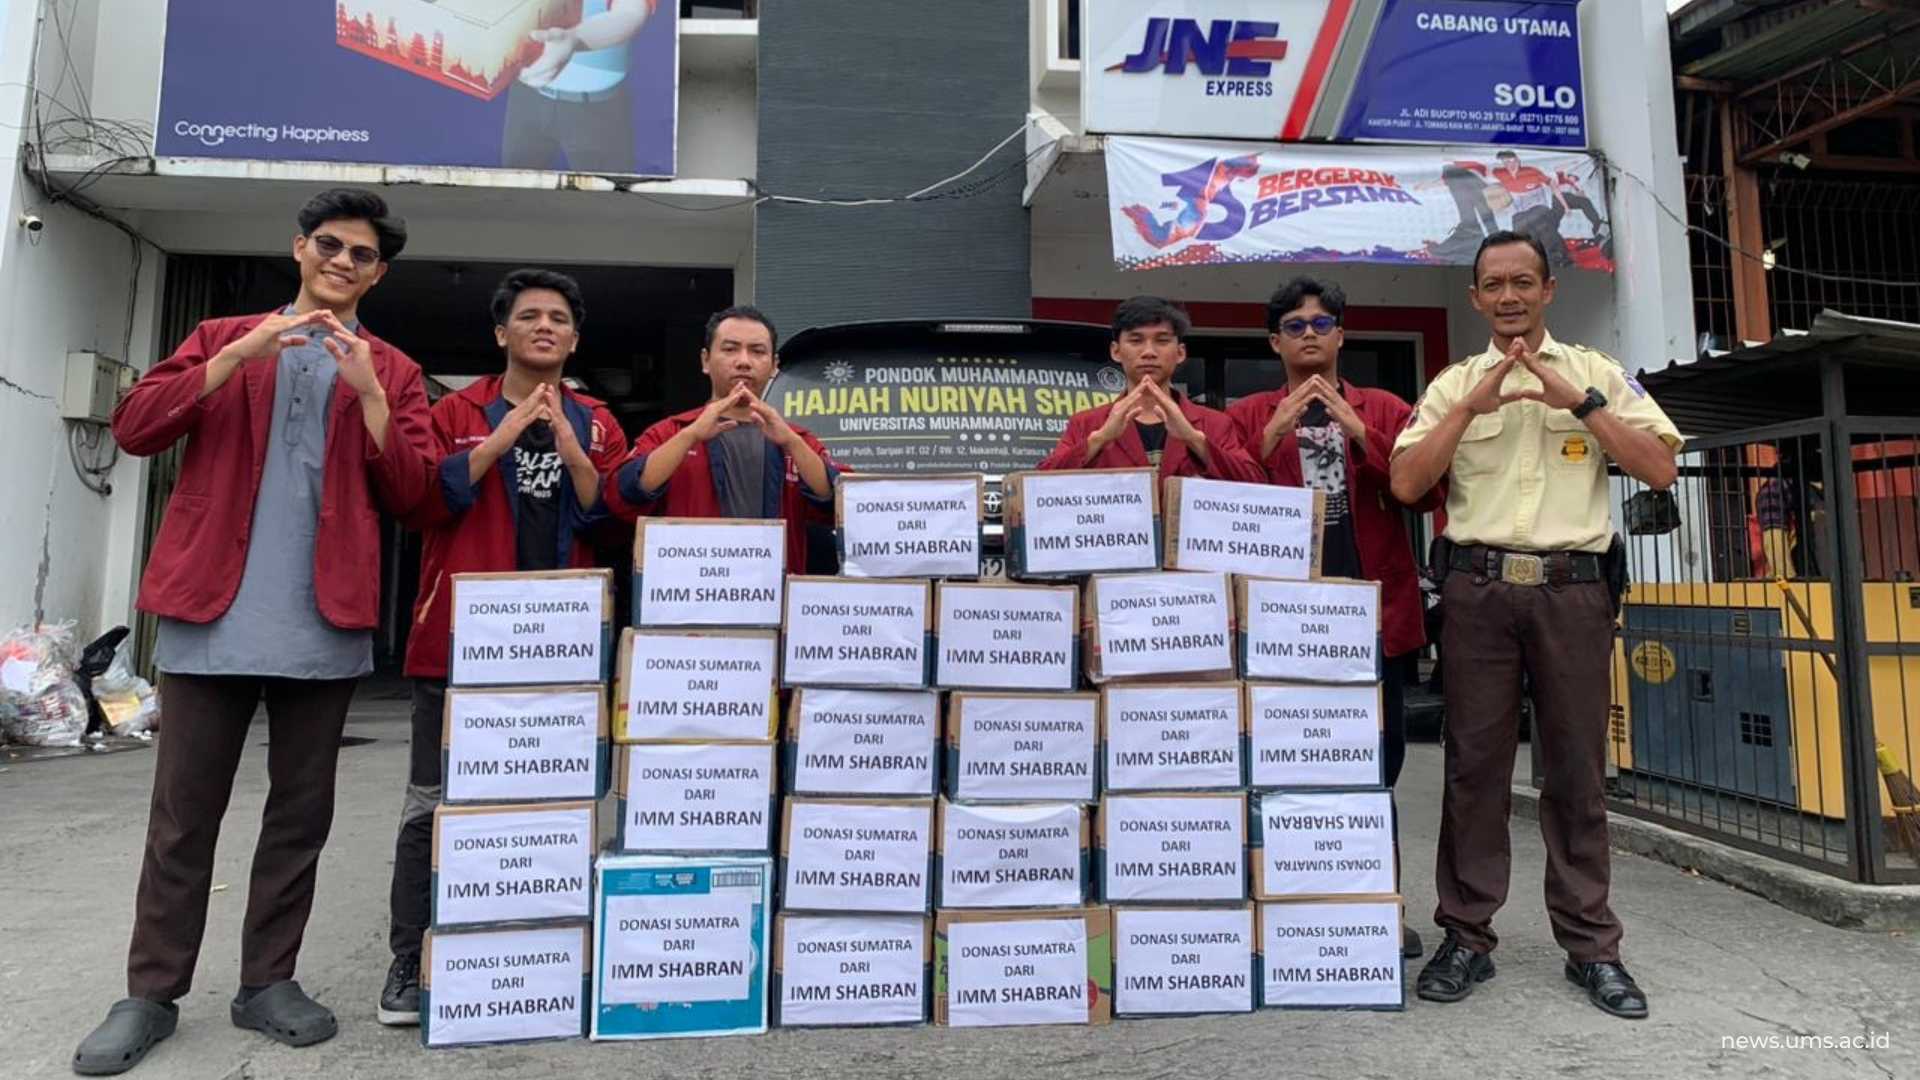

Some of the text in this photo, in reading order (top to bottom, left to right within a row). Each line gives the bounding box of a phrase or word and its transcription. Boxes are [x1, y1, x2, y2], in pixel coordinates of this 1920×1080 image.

[1416, 13, 1572, 38] CABANG UTAMA
[1106, 17, 1288, 77] JNE
[1206, 80, 1272, 97] EXPRESS
[1494, 83, 1576, 109] SOLO
[1414, 108, 1429, 118] ADI
[175, 121, 370, 144] Connecting Happiness
[1257, 167, 1401, 200] BERGERAK
[1249, 186, 1422, 229] BERSAMA
[865, 367, 1089, 387] PONDOK MUHAMMADIYAH
[784, 386, 890, 417] HAJJAH
[900, 386, 1027, 414] NURIYAH
[840, 417, 1069, 432] UNIVERSITAS MUHAMMADIYAH SUR
[855, 499, 968, 514] DONASI SUMATRA
[1036, 493, 1143, 508] DONASI SUMATRA
[1192, 498, 1302, 520] DONASI SUMATRA
[897, 519, 927, 532] DARI
[1076, 512, 1105, 526] DARI
[1231, 520, 1261, 534] DARI
[851, 539, 972, 557] IMM SHABRAN
[1033, 531, 1150, 551] IMM SHABRAN
[1186, 537, 1305, 561] IMM SHABRAN
[657, 546, 773, 560] DONASI SUMATRA
[699, 566, 730, 578] DARI
[650, 587, 776, 603] IMM SHABRAN
[1110, 592, 1218, 612] DONASI SUMATRA
[468, 600, 590, 616] DONASI SUMATRA
[801, 603, 914, 618] DONASI SUMATRA
[1260, 601, 1368, 618] DONASI SUMATRA
[512, 622, 545, 635] DARI
[1151, 614, 1181, 628] DARI
[1300, 622, 1330, 635] DARI
[841, 623, 873, 637] DARI
[462, 642, 595, 661] IMM SHABRAN
[1108, 632, 1225, 655] IMM SHABRAN
[1255, 640, 1372, 660] IMM SHABRAN
[794, 645, 918, 662] IMM SHABRAN
[645, 658, 762, 673] DONASI SUMATRA
[687, 678, 719, 692] DARI
[636, 700, 764, 718] IMM SHABRAN
[1264, 707, 1369, 721] DONASI SUMATRA
[973, 719, 1085, 733] DONASI SUMATRA
[1302, 727, 1332, 740] DARI
[1013, 740, 1044, 753] DARI
[1259, 747, 1375, 764] IMM SHABRAN
[966, 759, 1088, 777] IMM SHABRAN
[1119, 819, 1232, 833] DONASI SUMATRA
[1268, 814, 1385, 831] IMM SHABRAN
[453, 832, 579, 852] DONASI SUMATRA
[803, 826, 918, 842] DONASI SUMATRA
[1160, 839, 1191, 853] DARI
[1314, 839, 1343, 852] DARI
[499, 855, 534, 871] DARI
[844, 848, 876, 862] DARI
[1114, 860, 1237, 878] IMM SHABRAN
[1273, 858, 1382, 873] DONASI SUMATRA
[794, 869, 922, 889] IMM SHABRAN
[447, 876, 583, 900] IMM SHABRAN
[618, 916, 741, 932] DONASI SUMATRA
[1276, 925, 1389, 939] DONASI SUMATRA
[662, 938, 696, 953] DARI
[796, 937, 913, 954] DONASI SUMATRA
[960, 941, 1077, 959] DONASI SUMATRA
[1318, 945, 1349, 958] DARI
[445, 951, 572, 972] DONASI SUMATRA
[611, 959, 744, 980] IMM SHABRAN
[839, 959, 871, 975] DARI
[1003, 964, 1035, 978] DARI
[1272, 965, 1395, 984] IMM SHABRAN
[491, 975, 525, 991] DARI
[789, 981, 918, 1002] IMM SHABRAN
[956, 983, 1083, 1005] IMM SHABRAN
[438, 994, 576, 1021] IMM SHABRAN
